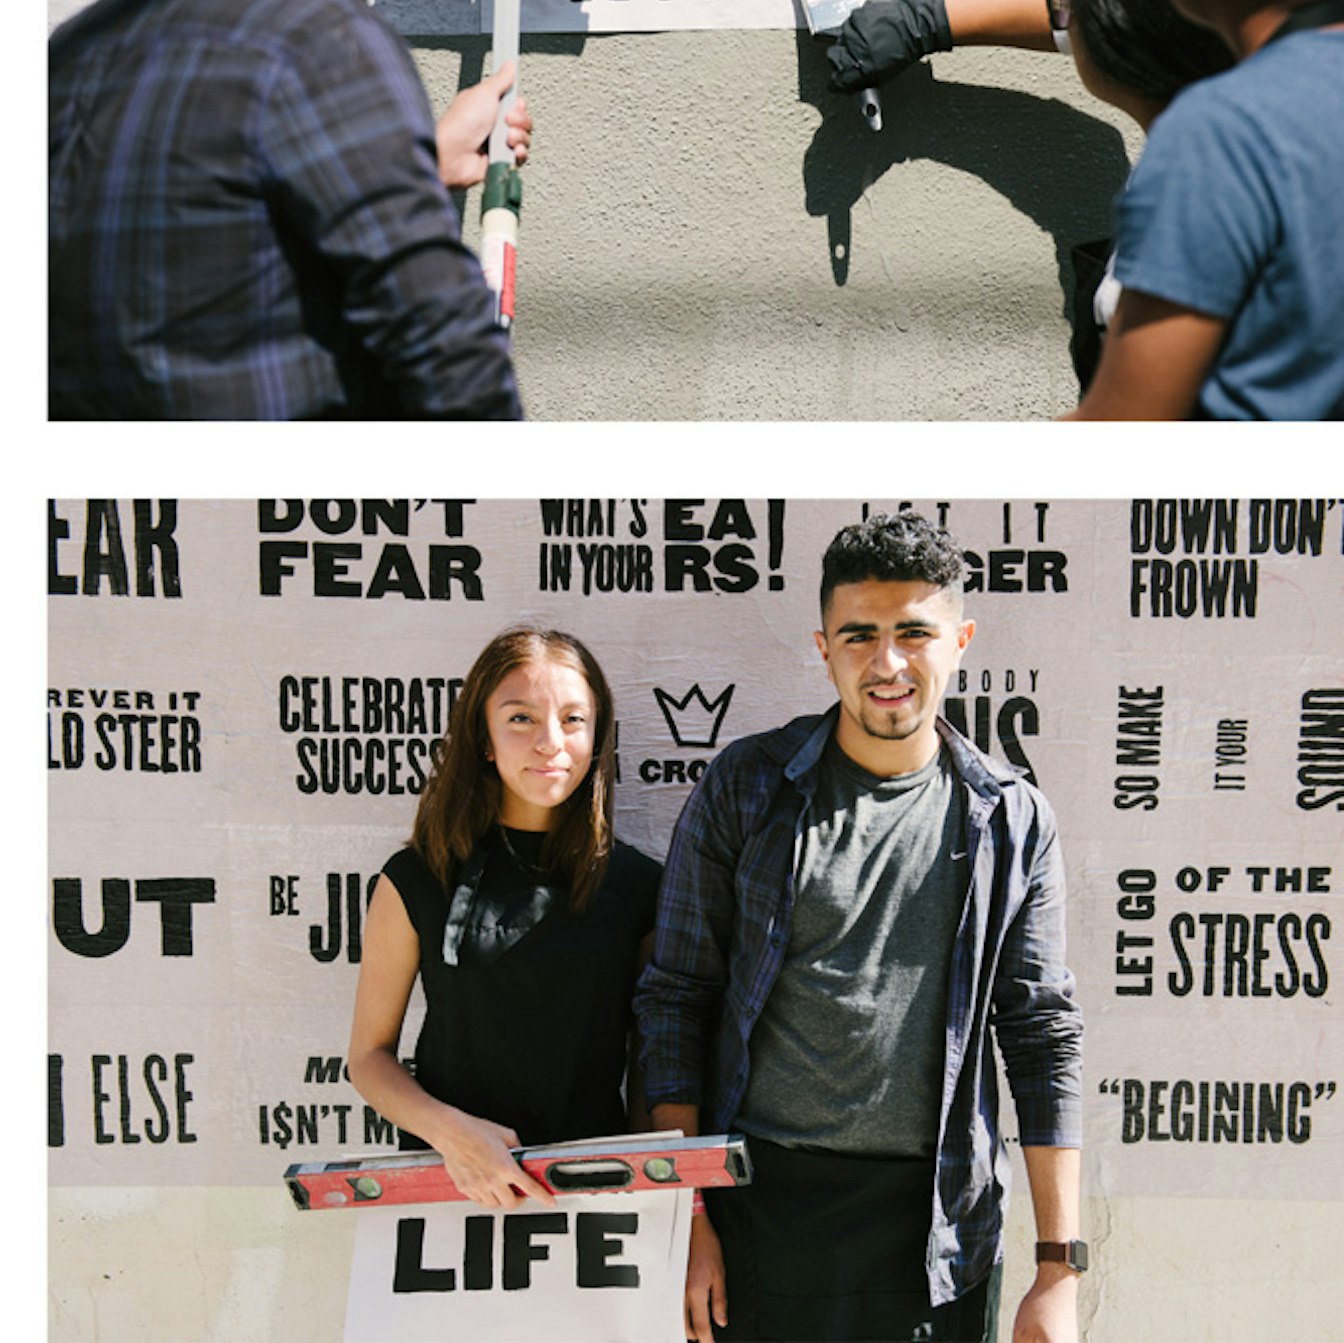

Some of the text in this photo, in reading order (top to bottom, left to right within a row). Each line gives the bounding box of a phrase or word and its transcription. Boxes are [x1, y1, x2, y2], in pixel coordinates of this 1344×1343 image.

[48, 499, 182, 597] EAR
[1003, 502, 1049, 544] IT
[1130, 499, 1238, 555] DOWN
[259, 541, 484, 601] FEAR
[539, 543, 571, 591] IN
[576, 542, 653, 596] YOUR
[963, 550, 1069, 592] GER
[1130, 559, 1258, 618] FROWN
[48, 689, 201, 711] REVER IT
[96, 714, 202, 773] STEER
[639, 759, 708, 784] CRO
[1113, 685, 1164, 811] SO MAKE
[1213, 719, 1248, 791] IT YOUR
[269, 875, 301, 916] BE
[1176, 866, 1331, 892] OF THE
[53, 878, 217, 957] UT
[1116, 869, 1157, 996] LET GO
[1168, 912, 1331, 997] STRESS
[92, 1054, 197, 1143] ELSE
[393, 1212, 641, 1293] LIFE
